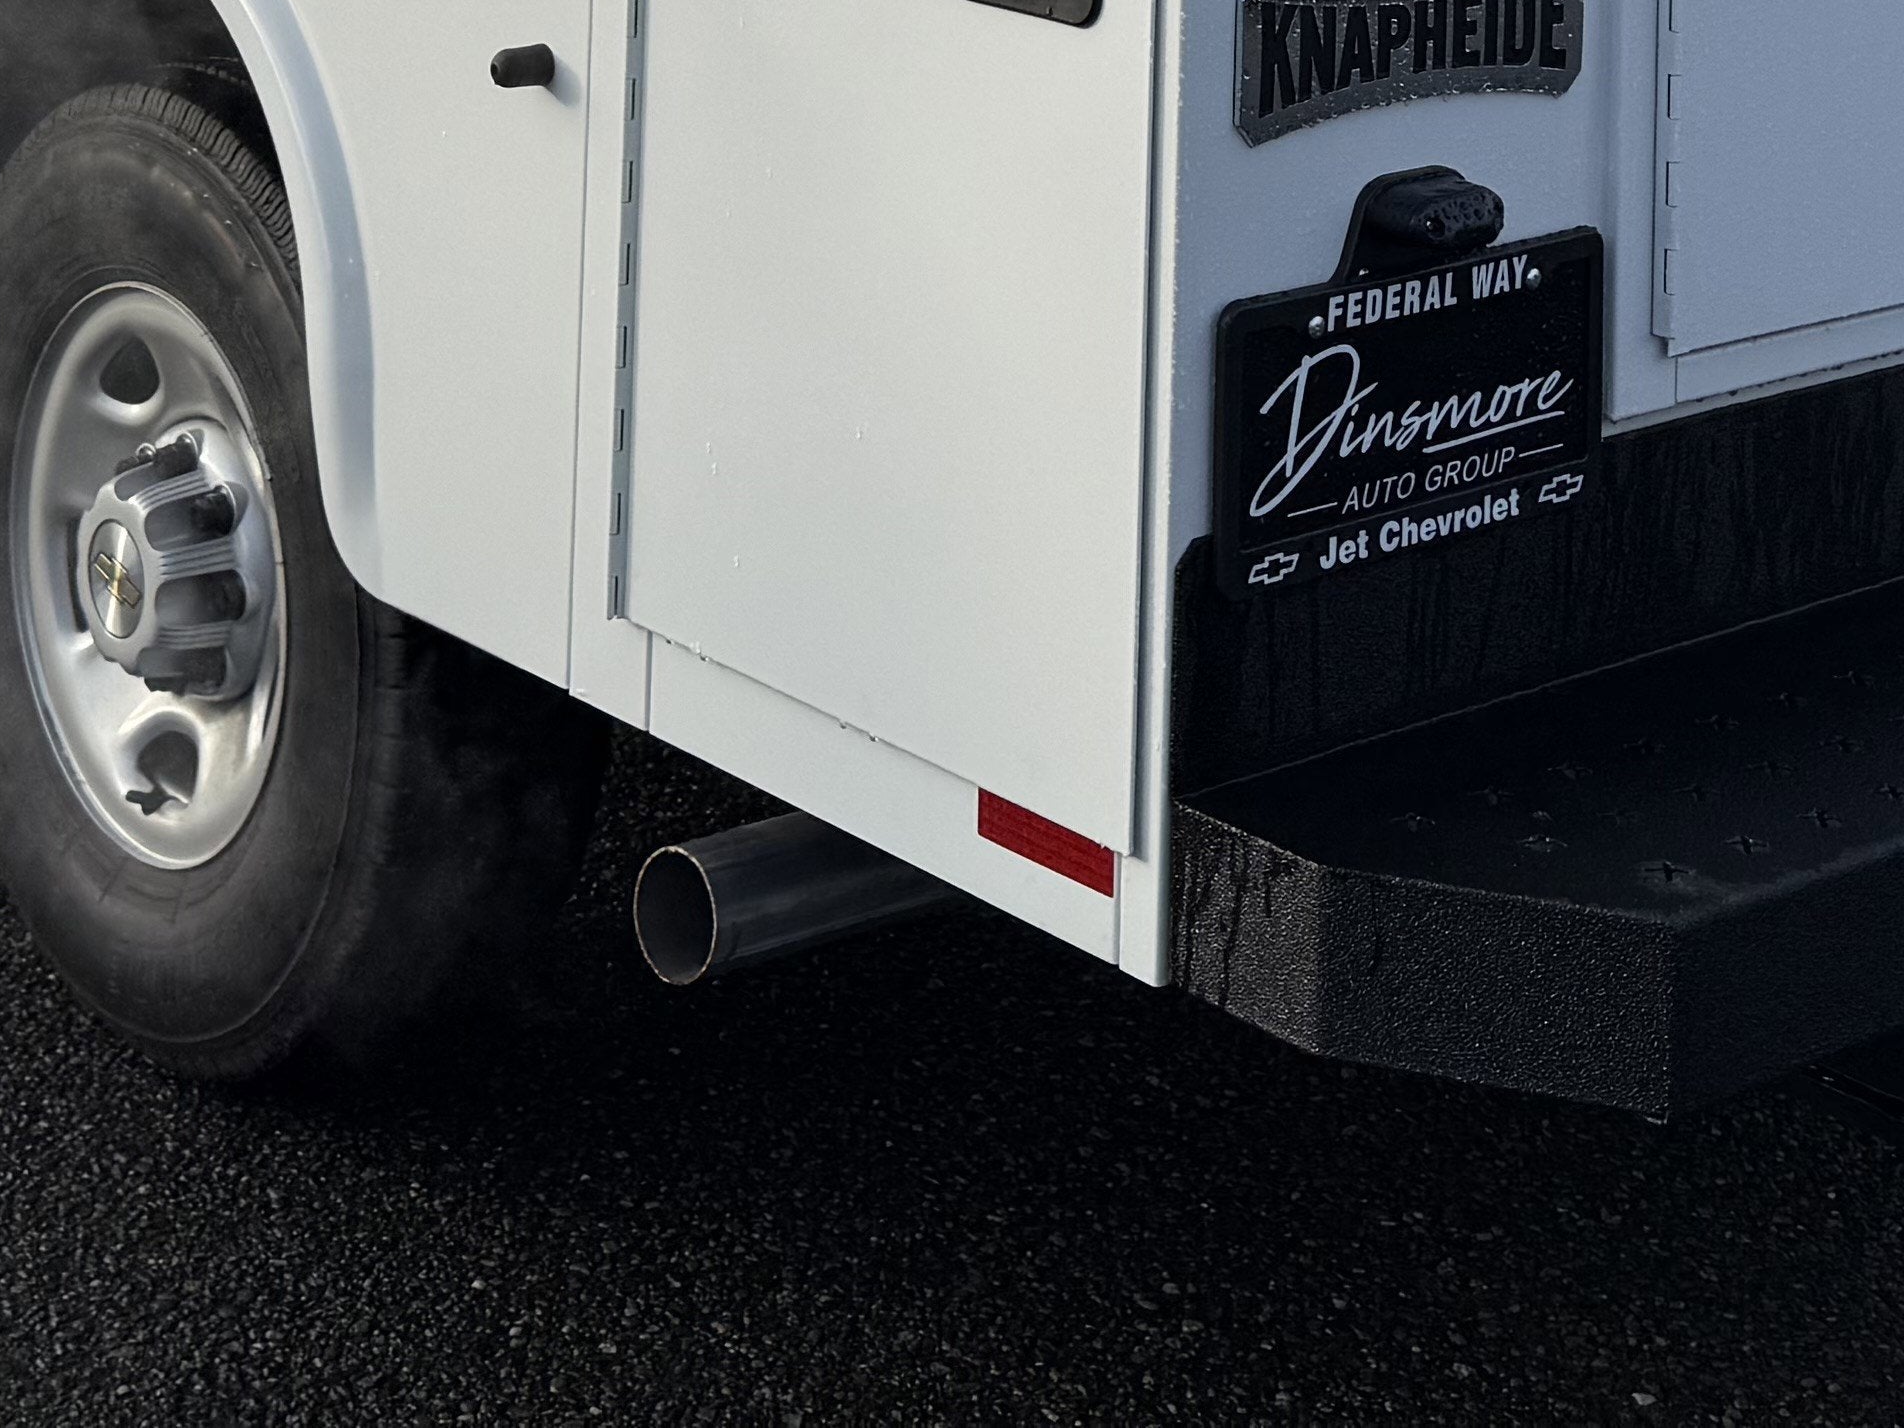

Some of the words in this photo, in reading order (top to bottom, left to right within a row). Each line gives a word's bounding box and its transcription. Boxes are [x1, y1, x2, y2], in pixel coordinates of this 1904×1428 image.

[1326, 271, 1458, 332] FEDERAL
[1471, 254, 1529, 300] WAY
[1248, 343, 1575, 518] Dinsmore
[1341, 471, 1417, 515] AUTO
[1424, 445, 1517, 492] GROUP
[1318, 529, 1370, 570] Jet
[1378, 487, 1521, 553] Chevrolet
